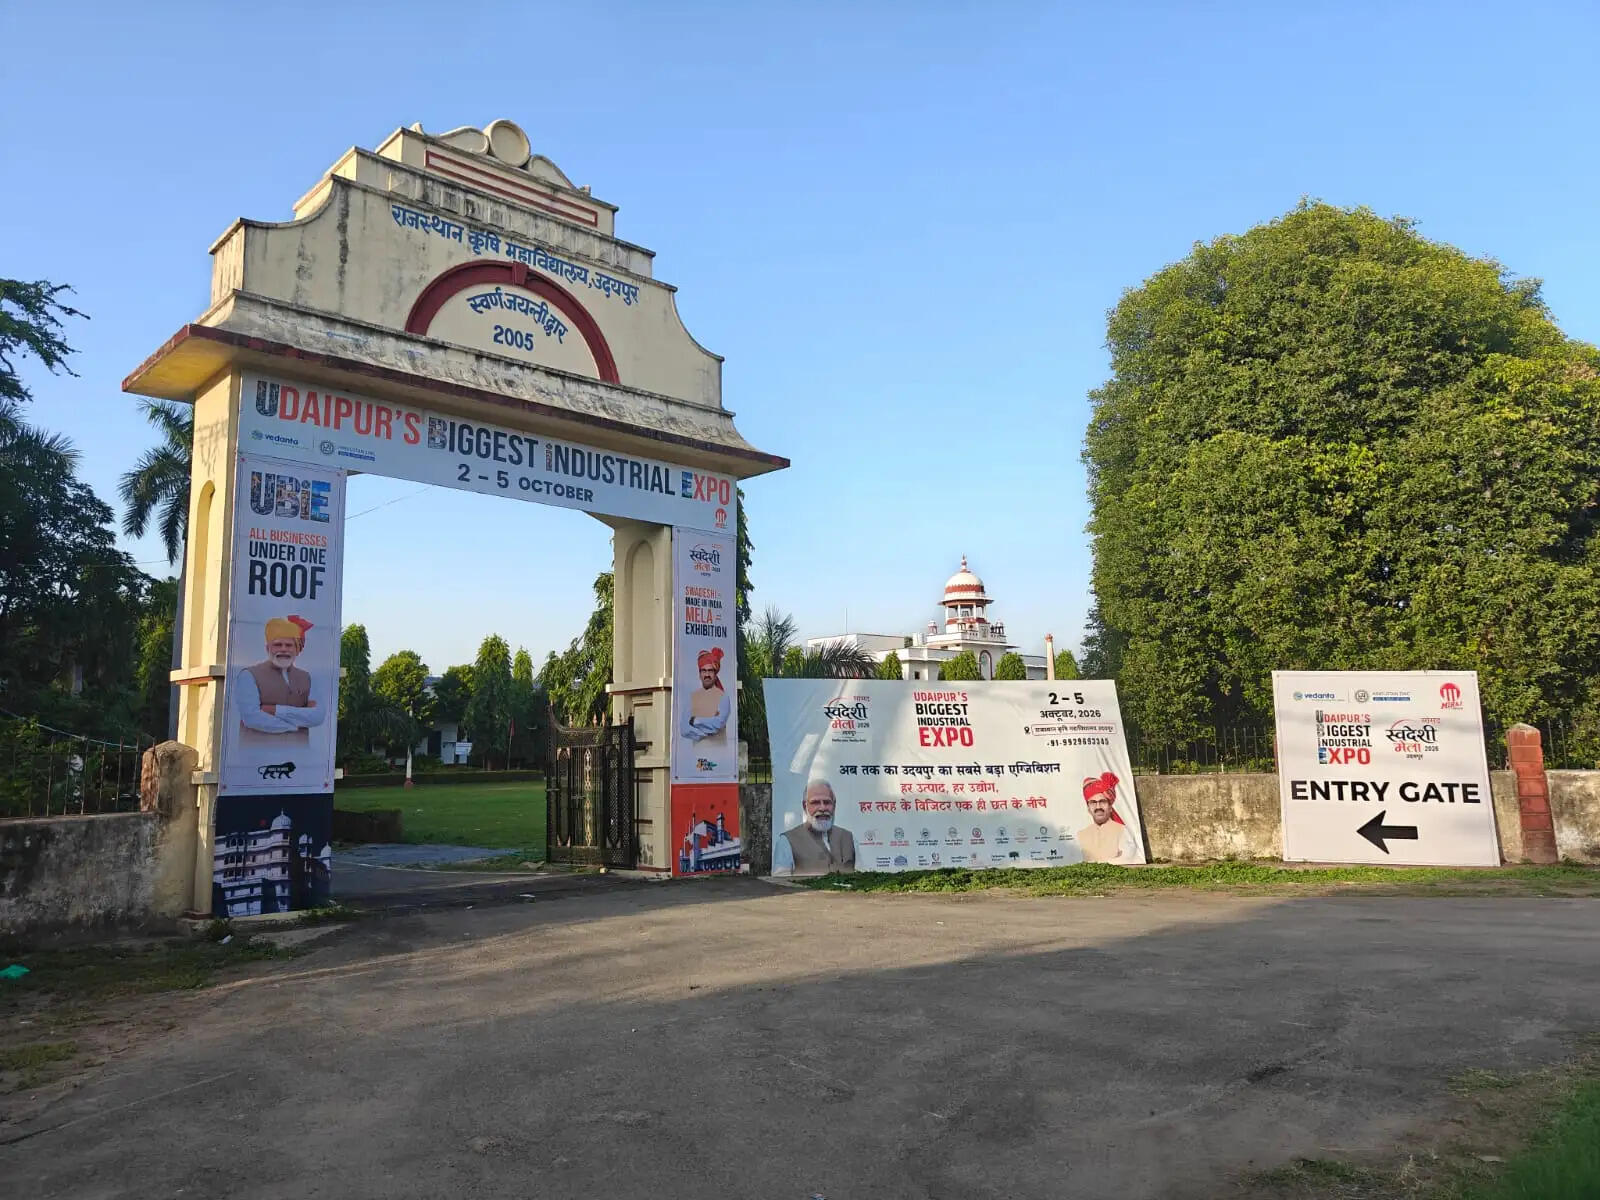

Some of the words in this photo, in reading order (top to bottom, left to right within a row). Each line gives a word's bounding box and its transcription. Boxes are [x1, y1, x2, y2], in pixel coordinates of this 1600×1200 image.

[392, 205, 463, 243] राजस्थान
[468, 231, 501, 255] कृषि
[493, 325, 534, 351] 2005
[255, 381, 421, 445] UDAIPUR'S
[427, 416, 539, 468] BIGGEST
[681, 471, 730, 506] EXPO
[264, 433, 299, 446] vedanta
[457, 464, 470, 483] 2
[496, 471, 510, 489] 5
[518, 476, 593, 502] OCTOBER
[249, 527, 268, 541] ALL
[248, 541, 296, 562] UNDER
[299, 546, 327, 565] ONE
[248, 559, 326, 600] ROOF
[685, 586, 717, 599] SWADESHI
[685, 597, 701, 606] MADE
[701, 599, 707, 607] IN
[708, 600, 722, 609] INDIA
[685, 607, 713, 624] MELA
[685, 622, 728, 638] EXHIBITION
[913, 691, 968, 702] UDAIPUR'S
[1048, 692, 1059, 705] 2
[1074, 692, 1085, 705] 5
[1304, 692, 1336, 700] vedanta
[824, 702, 869, 720] स्वदेशी
[915, 703, 969, 716] BIGGEST
[1040, 709, 1077, 722] अक्टूबर,
[1079, 710, 1102, 718] 2026
[1315, 710, 1371, 723] UDAIPUR'S
[830, 717, 856, 729] मेला
[917, 717, 971, 726] INDUSTRIAL
[918, 727, 974, 747] EXPO
[1316, 724, 1371, 737] BIGGEST
[1385, 725, 1437, 744] स्वदेशी
[1394, 740, 1422, 753] मेला
[1318, 747, 1371, 765] EXPO
[840, 765, 858, 775] अब
[861, 765, 880, 775] तक
[883, 765, 898, 775] का
[902, 765, 934, 780] उदयपुर
[938, 765, 953, 776] का
[956, 762, 982, 776] सबसे
[984, 764, 1005, 777] बड़ा
[1008, 760, 1061, 777] एग्जिबिशन
[900, 783, 913, 794] हर
[952, 783, 965, 795] हर
[1290, 780, 1389, 801] ENTRY
[1399, 781, 1481, 804] GATE
[859, 801, 873, 813] हर
[875, 801, 897, 813] तरह
[900, 798, 912, 811] के
[914, 798, 952, 812] विजिटर
[955, 800, 973, 811] एक
[976, 798, 986, 811] ही
[990, 800, 1008, 810] छत
[1010, 797, 1023, 809] के
[1025, 796, 1047, 809] नीचे
